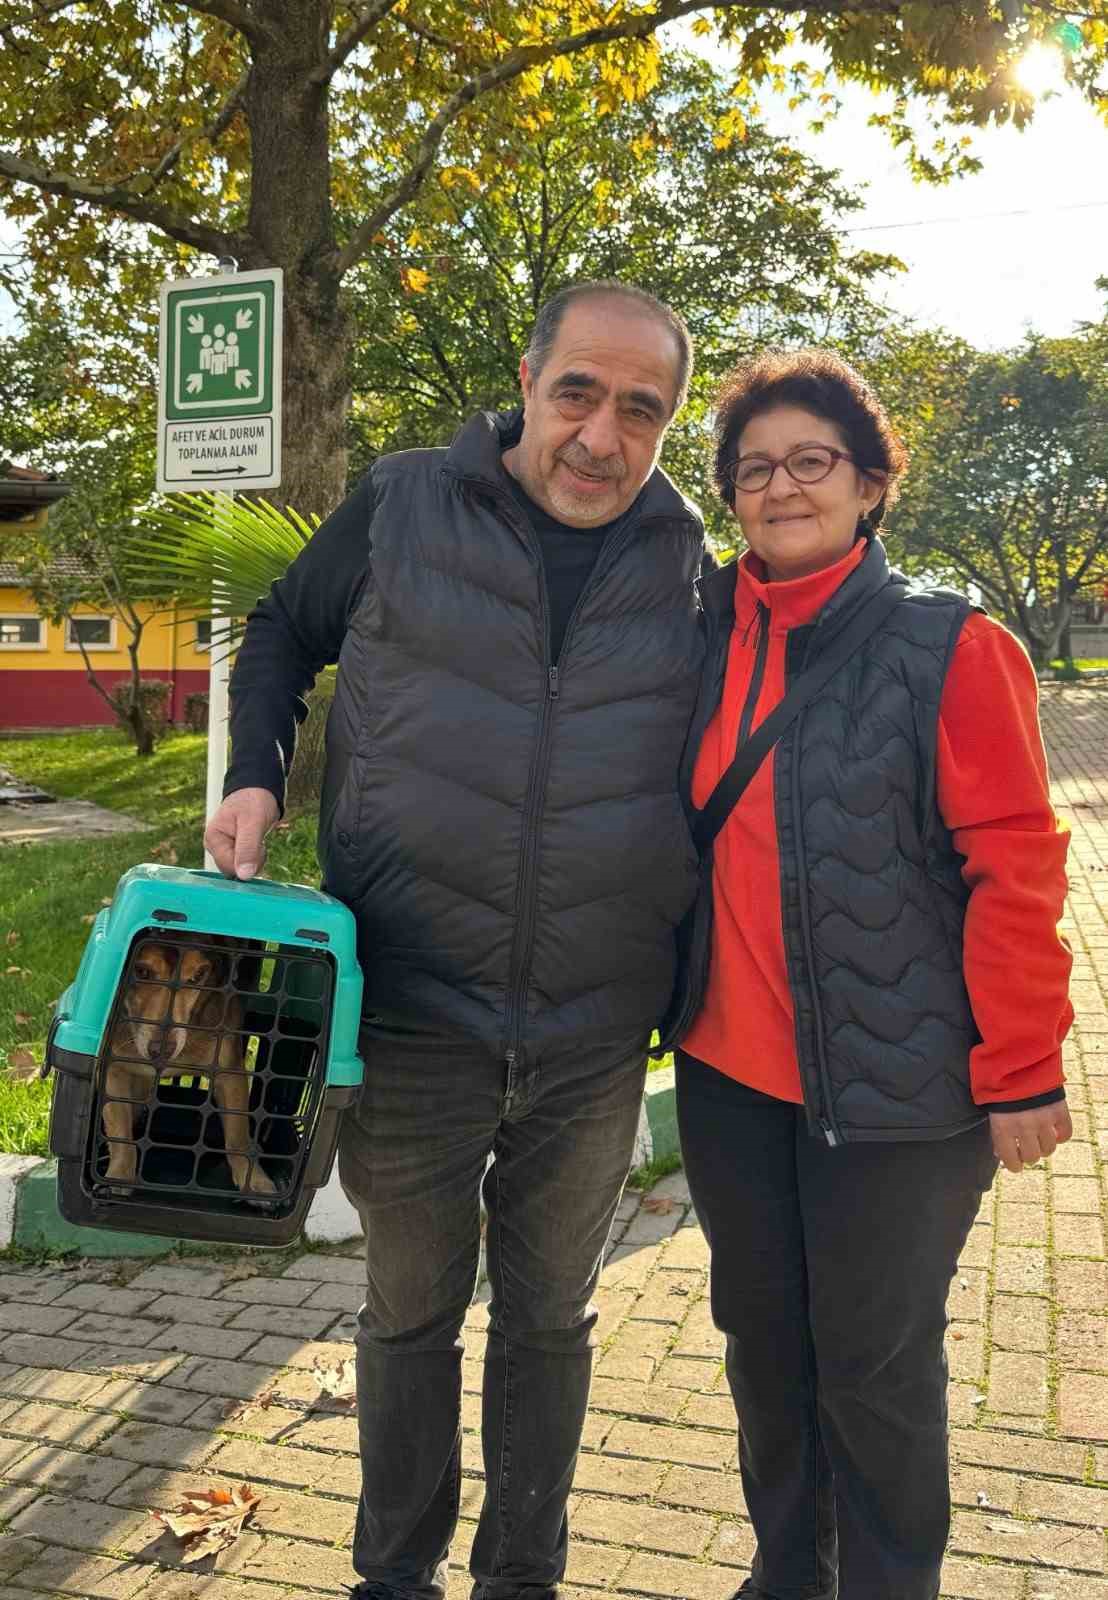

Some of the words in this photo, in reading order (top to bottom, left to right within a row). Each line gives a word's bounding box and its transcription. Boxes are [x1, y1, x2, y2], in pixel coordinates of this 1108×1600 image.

[172, 430, 194, 442] AFET
[195, 429, 207, 441] VE
[208, 426, 228, 441] ACİL
[230, 425, 265, 440] DURUM
[178, 446, 227, 460] TOPLANMA
[229, 444, 257, 457] ALANI
